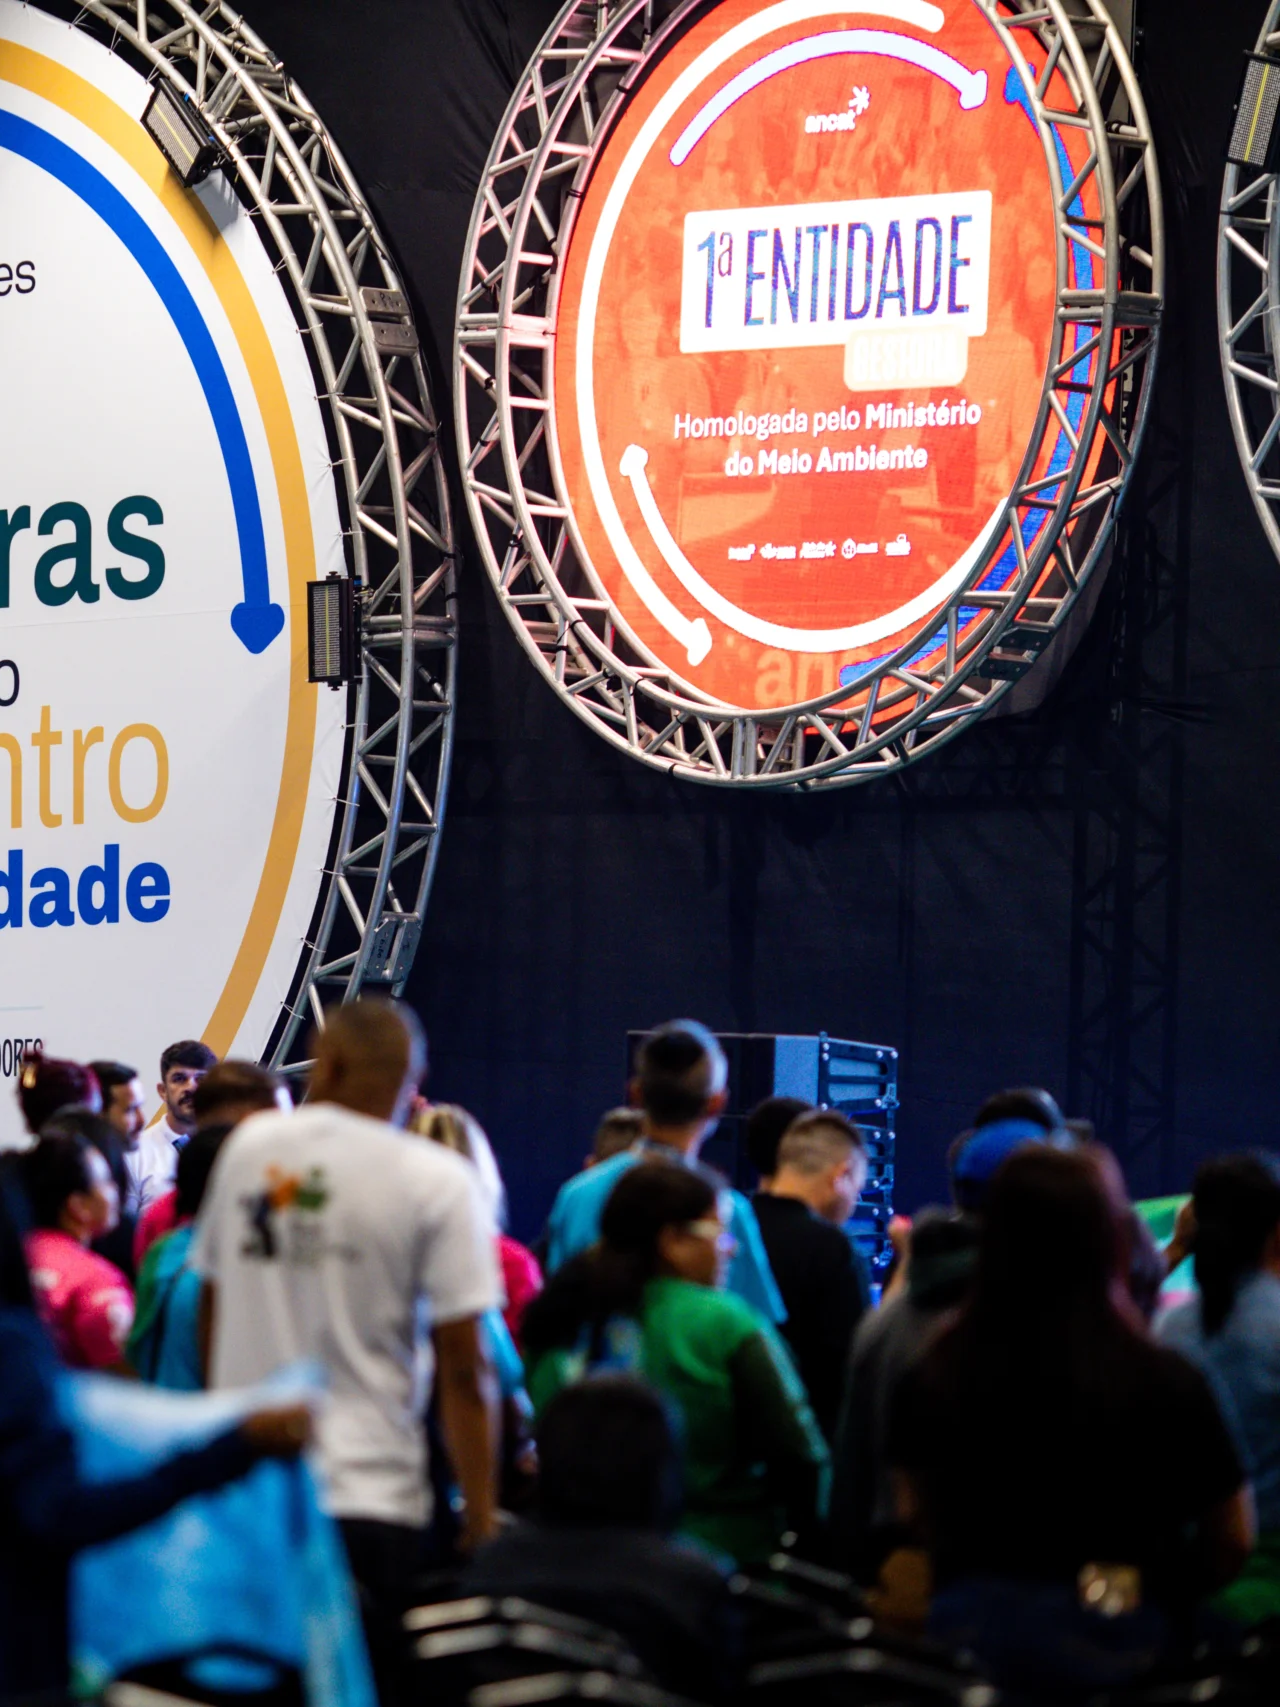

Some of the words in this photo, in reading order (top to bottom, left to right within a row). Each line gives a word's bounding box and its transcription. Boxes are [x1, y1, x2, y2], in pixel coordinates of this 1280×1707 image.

[805, 109, 857, 133] ancat
[744, 214, 973, 326] ENTIDADE
[674, 408, 808, 441] Homologada
[813, 406, 861, 437] pelo
[865, 399, 982, 430] Ministério
[724, 451, 754, 476] do
[757, 447, 812, 475] Meio
[815, 443, 928, 472] Ambiente
